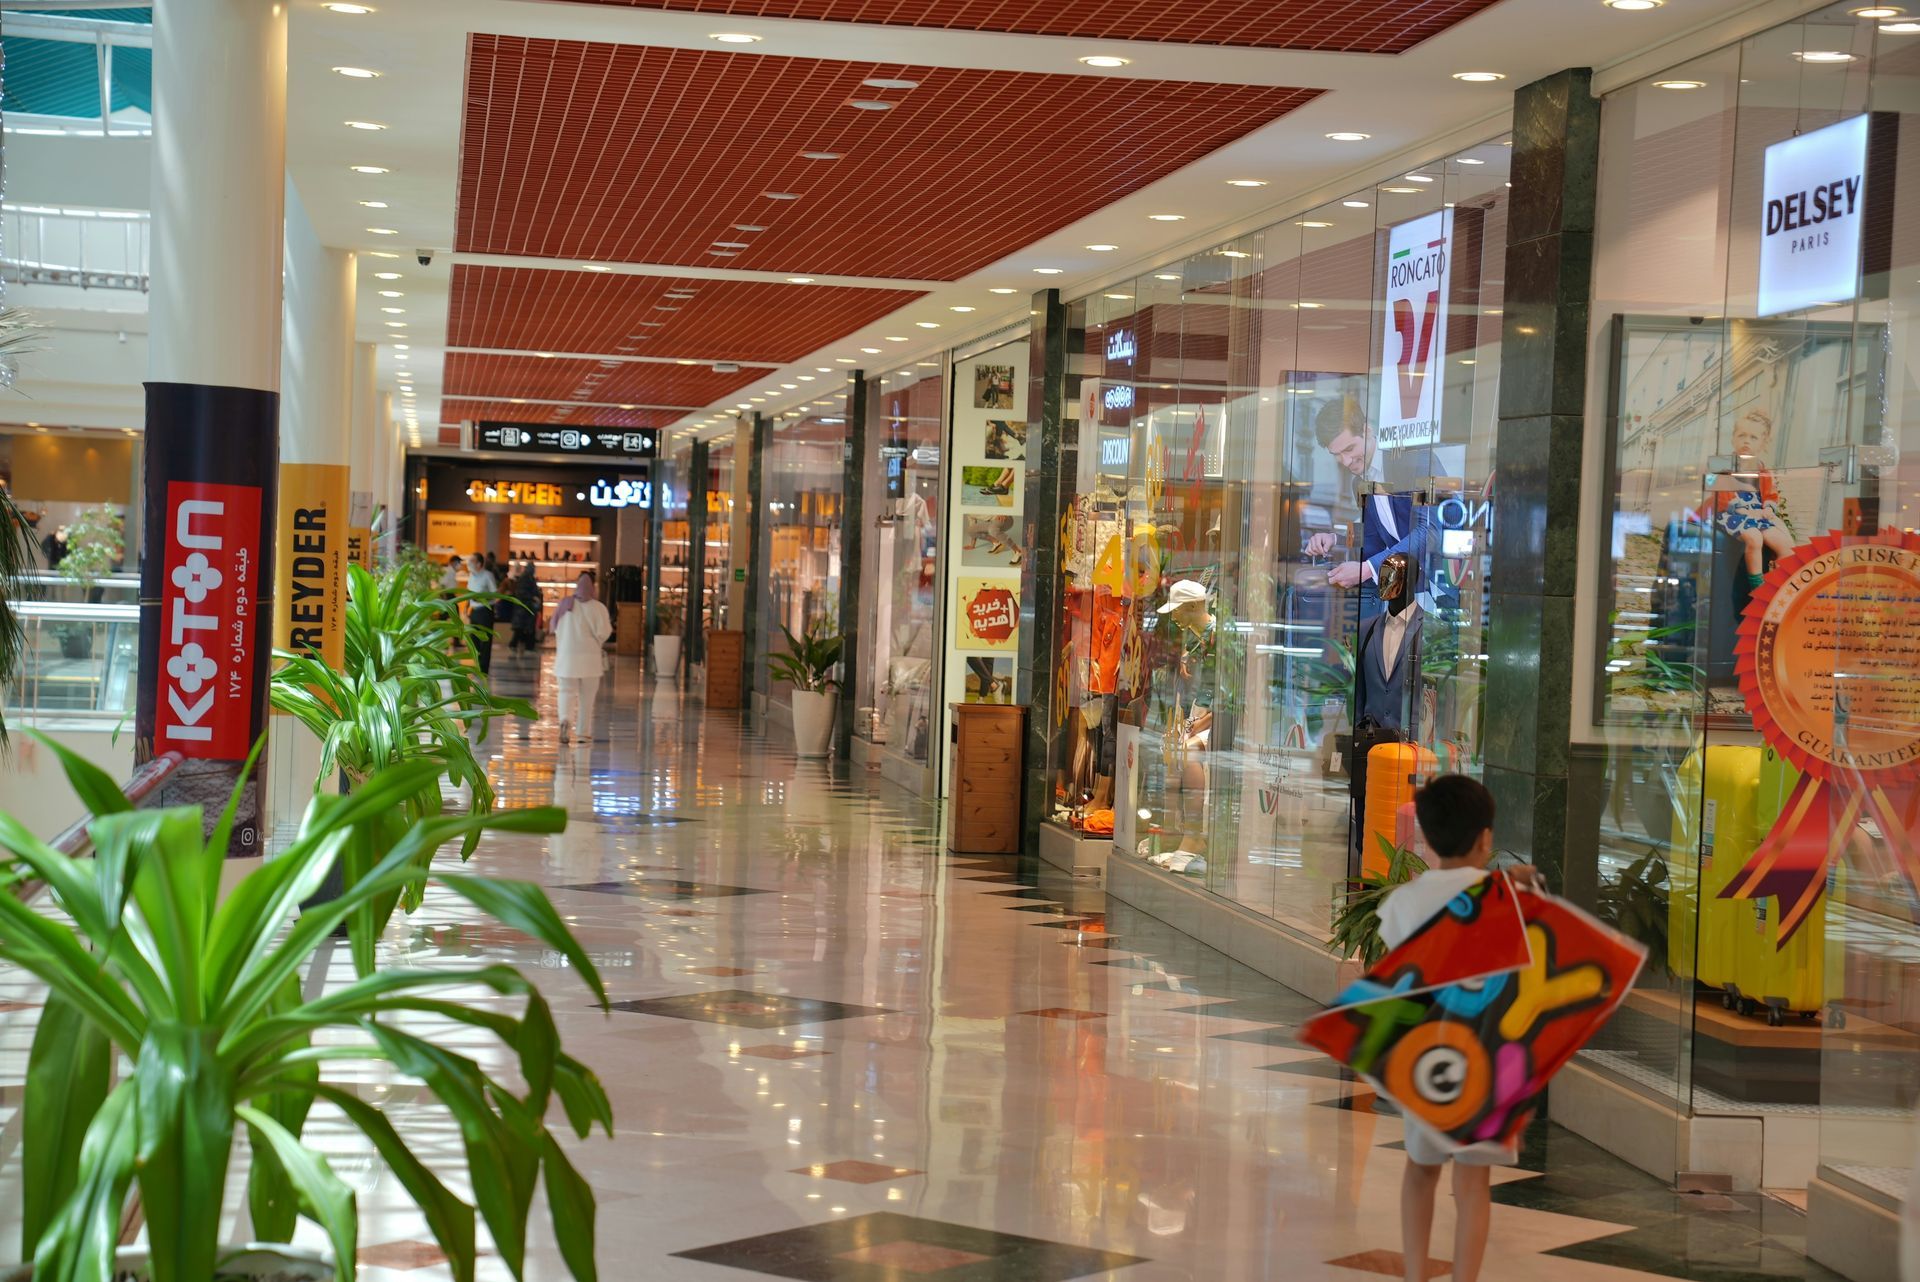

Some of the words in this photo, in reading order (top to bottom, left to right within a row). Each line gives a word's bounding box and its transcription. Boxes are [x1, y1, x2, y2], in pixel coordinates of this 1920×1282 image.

[1766, 175, 1861, 236] DELSEY
[1791, 232, 1829, 254] PARIS
[1391, 251, 1446, 289] RONCATO
[1379, 425, 1398, 442] MOVE
[1398, 423, 1415, 440] YOUR
[1415, 419, 1439, 438] DREAM
[1103, 438, 1131, 464] DISCOUN
[235, 547, 248, 581] طبقه
[1091, 533, 1161, 598] 40
[1789, 552, 1842, 592] 100%
[1852, 548, 1903, 566] RISK
[236, 586, 248, 617] دوم
[972, 598, 1000, 616] خرید
[166, 499, 225, 741] KOTON
[973, 613, 1008, 632] هدیه
[230, 619, 246, 663] شماره
[1798, 730, 1920, 767] GUARANTEE
